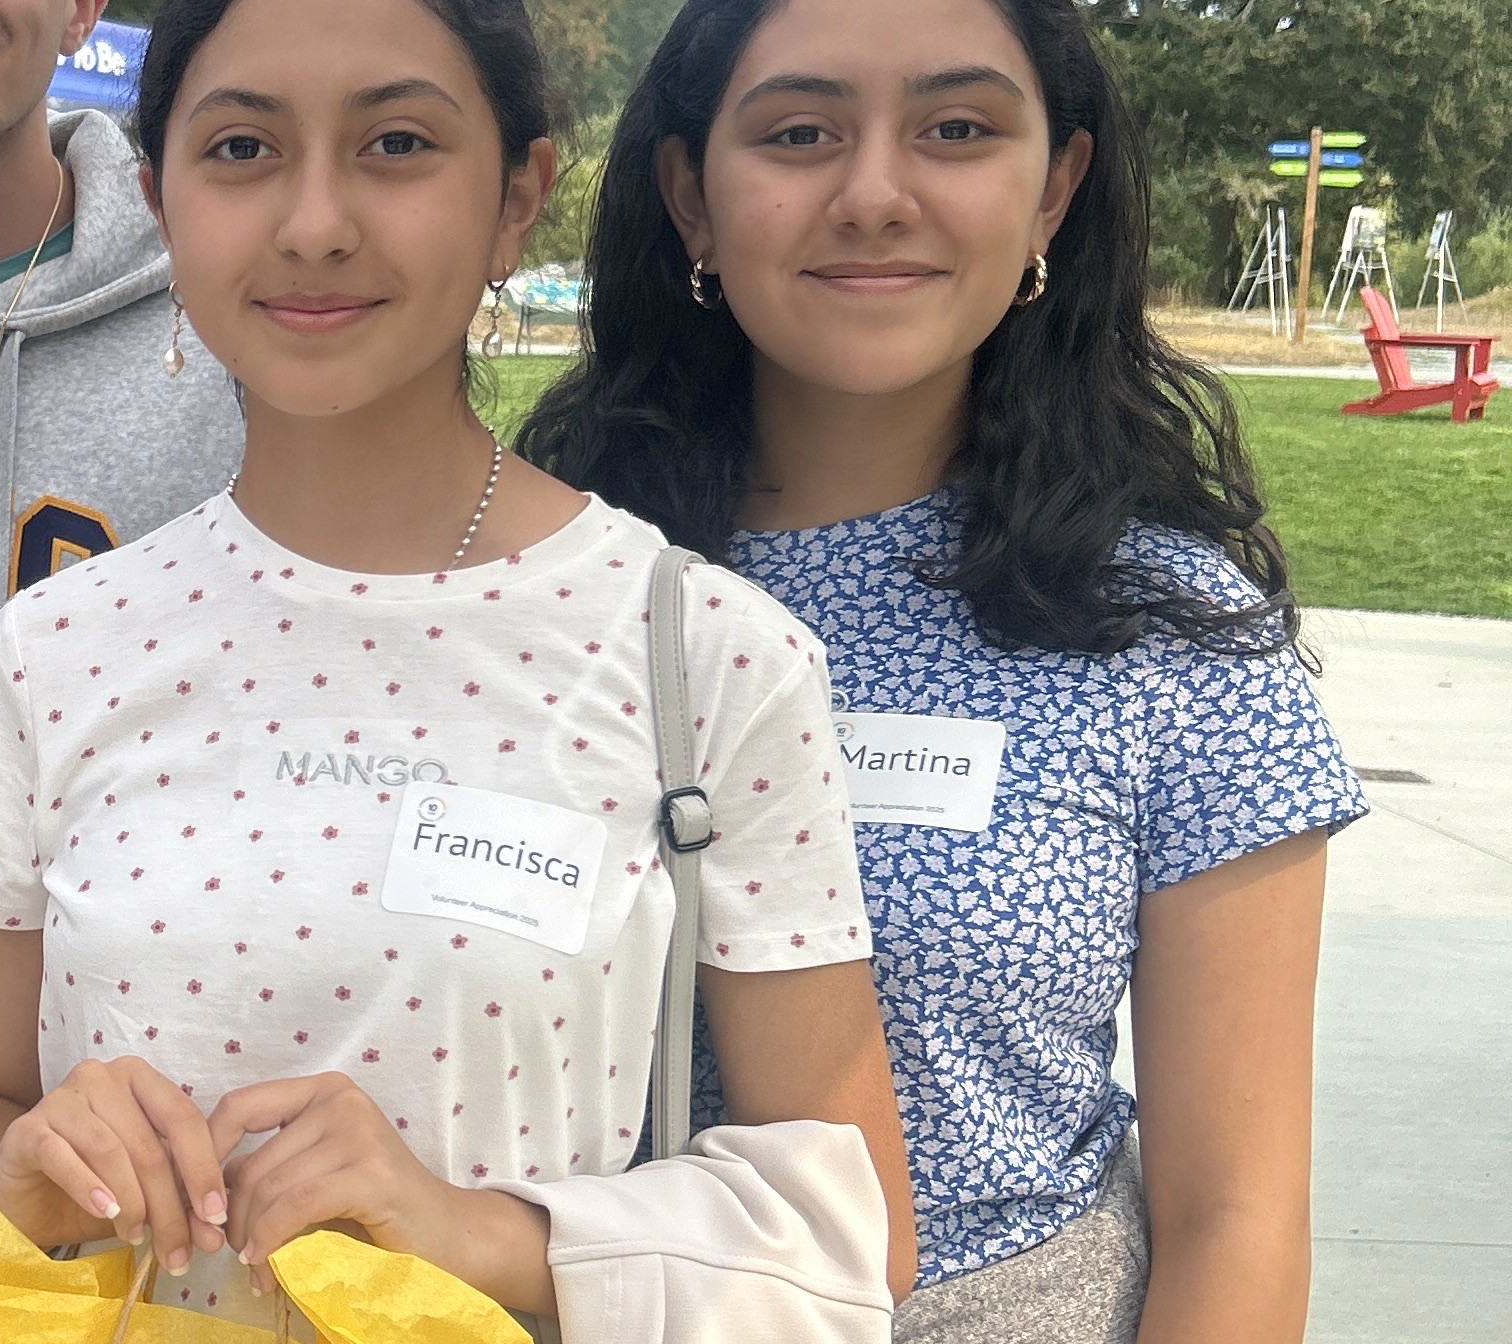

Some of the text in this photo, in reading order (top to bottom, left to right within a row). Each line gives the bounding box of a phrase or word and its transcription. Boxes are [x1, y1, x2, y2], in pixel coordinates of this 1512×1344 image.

[275, 750, 449, 786] MANGO
[840, 743, 971, 777] Martina
[412, 822, 581, 889] Francisca
